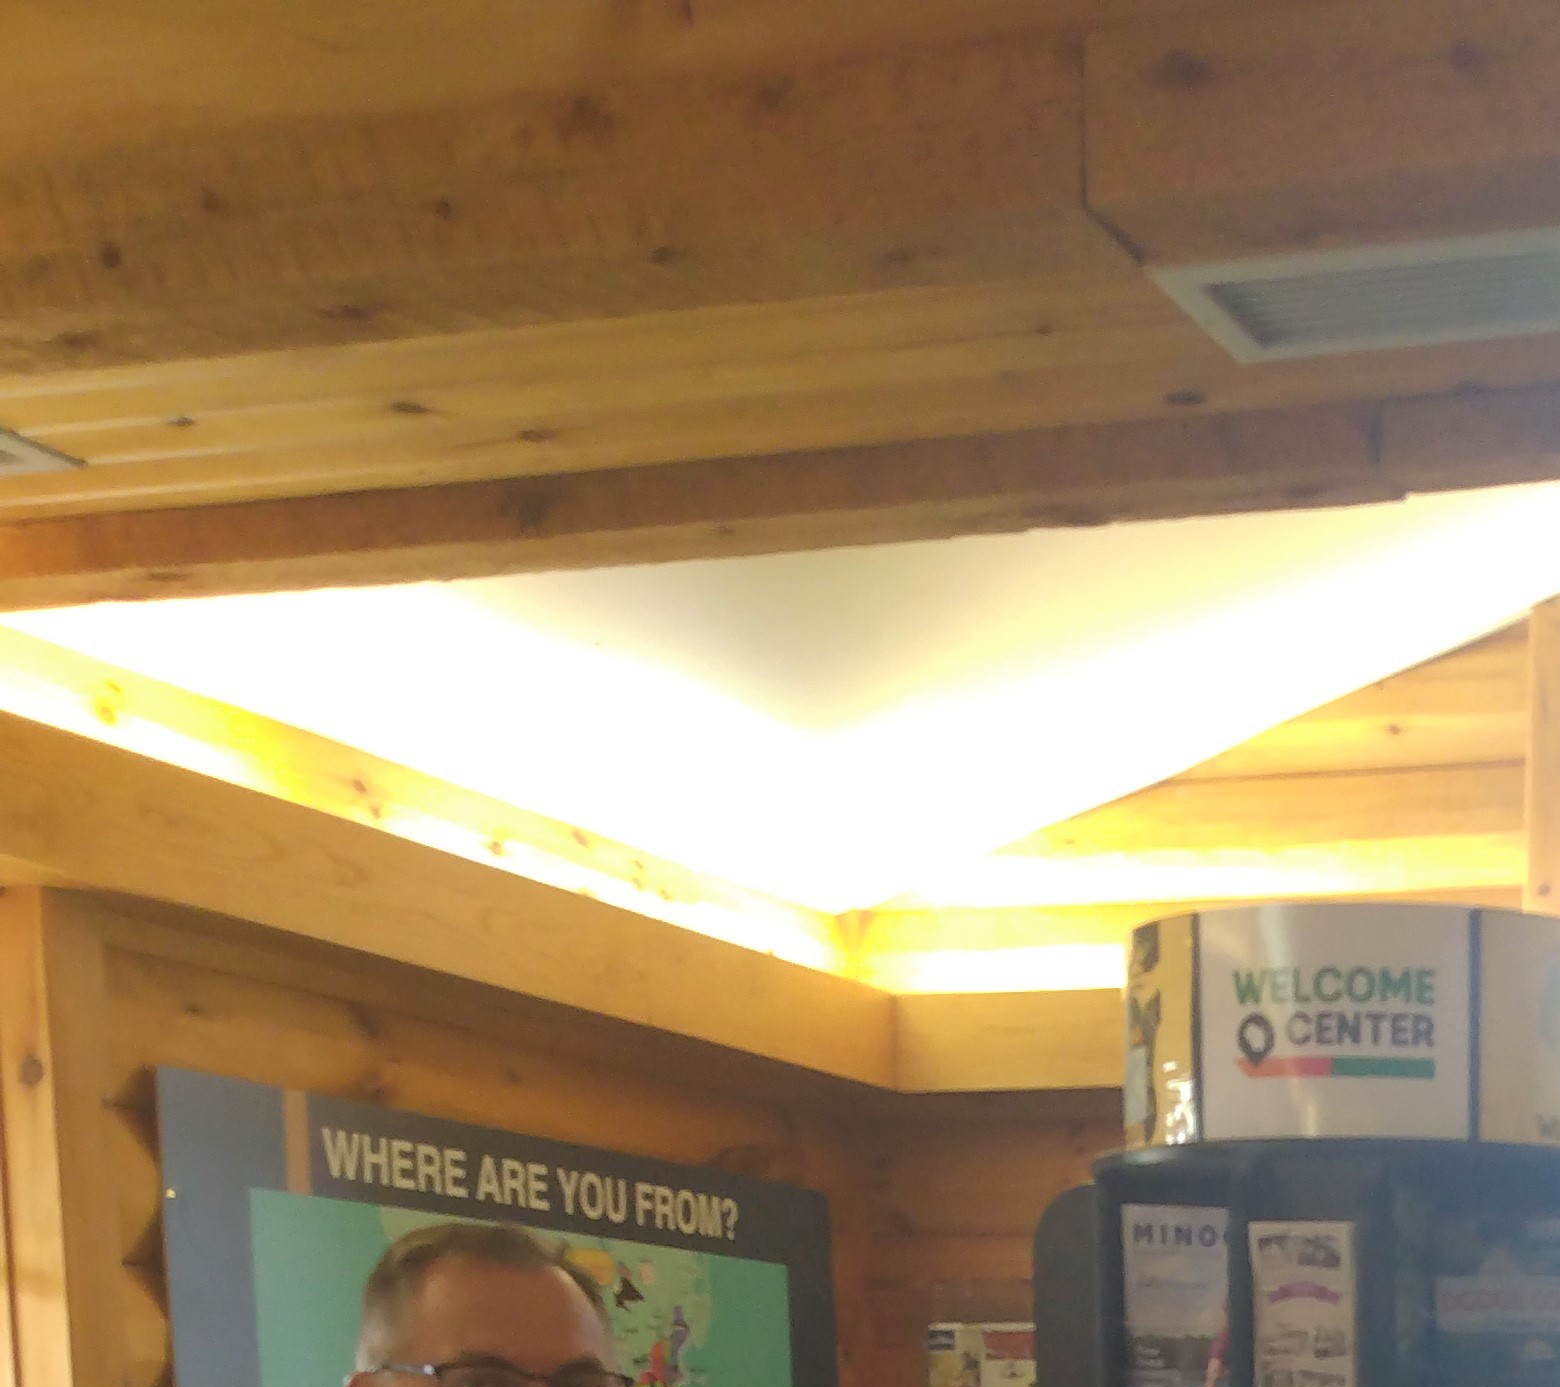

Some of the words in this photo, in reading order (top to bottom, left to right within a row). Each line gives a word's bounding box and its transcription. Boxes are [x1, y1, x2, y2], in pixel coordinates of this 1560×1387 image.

[1232, 965, 1436, 1004] WELCOME
[1285, 1010, 1435, 1047] CENTER
[321, 1126, 470, 1199] WHERE
[476, 1154, 551, 1212] ARE
[555, 1166, 628, 1225] YOU
[633, 1181, 741, 1242] FROM?
[1132, 1223, 1229, 1248] MINO
